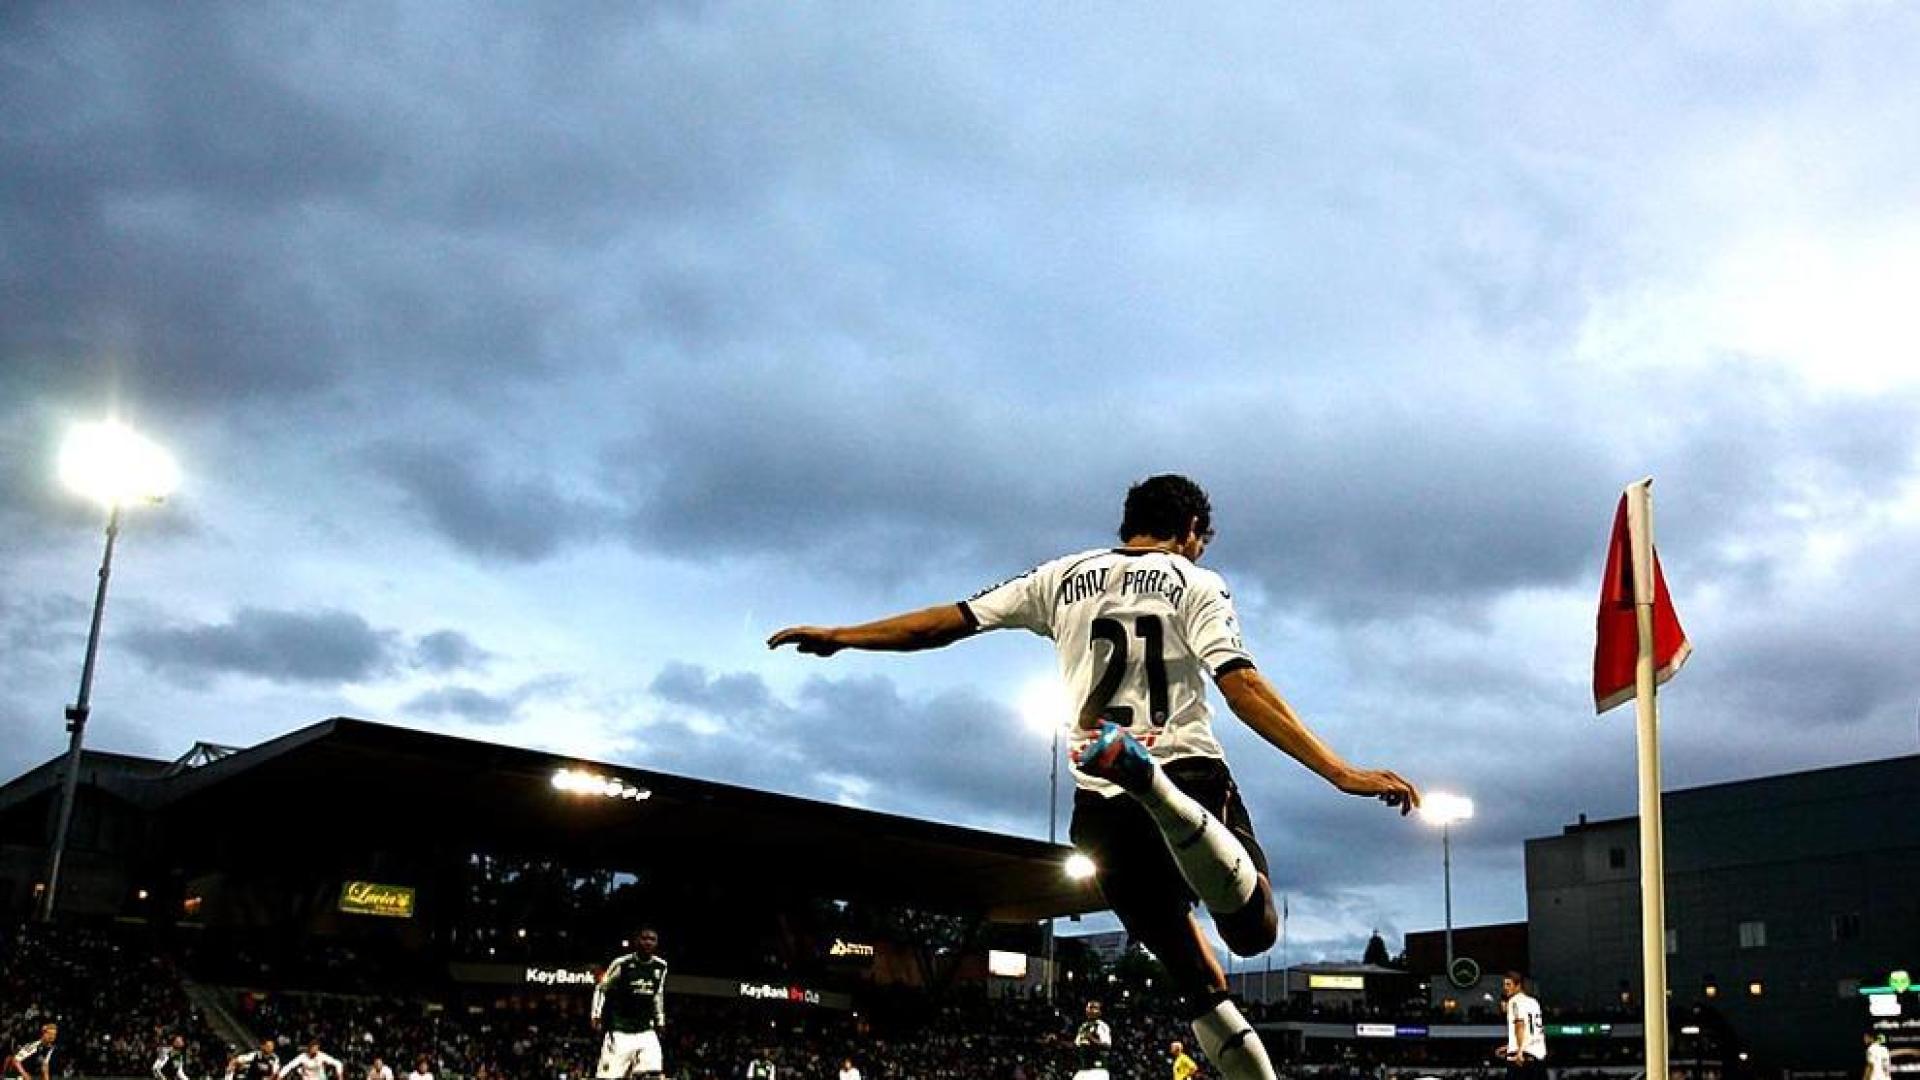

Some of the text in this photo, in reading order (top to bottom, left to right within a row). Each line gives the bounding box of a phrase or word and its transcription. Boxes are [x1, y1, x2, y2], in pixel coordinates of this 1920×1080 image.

[1063, 567, 1108, 605] DANI
[1078, 614, 1169, 731] 21
[526, 968, 595, 985] KeyBank
[740, 983, 789, 999] KeyBank
